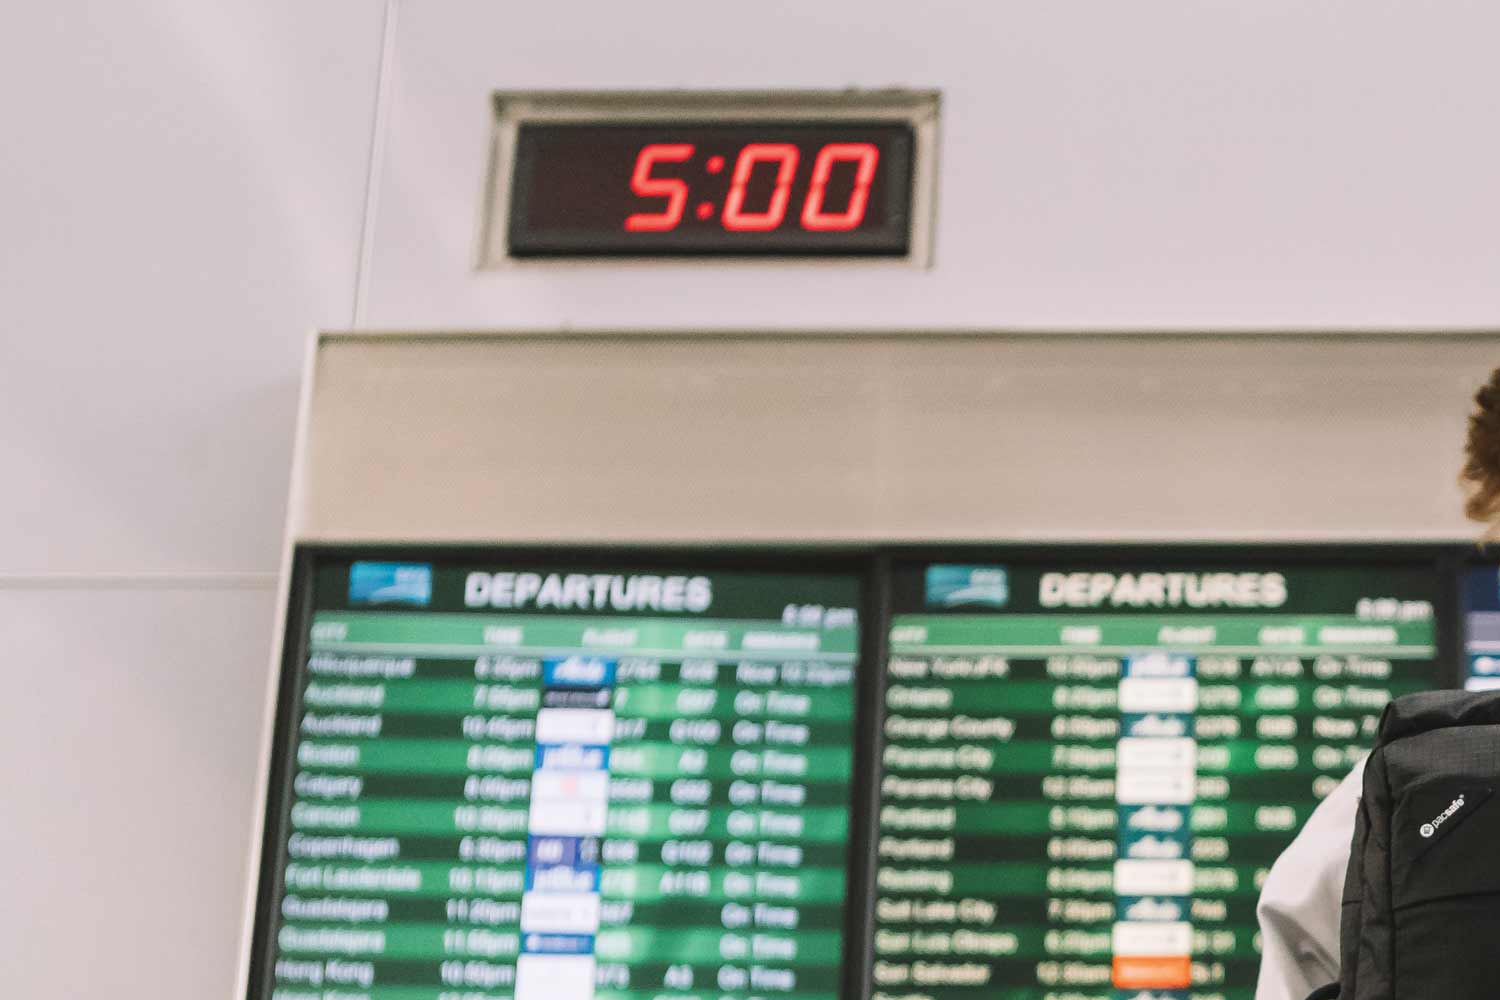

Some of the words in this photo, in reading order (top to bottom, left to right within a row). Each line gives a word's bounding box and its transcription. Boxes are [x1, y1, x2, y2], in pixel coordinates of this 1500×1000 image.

[624, 143, 879, 232] 5:00
[465, 573, 711, 609] DEPARTURES
[1040, 573, 1286, 606] DEPARTURES
[1432, 799, 1465, 829] pacsafe
